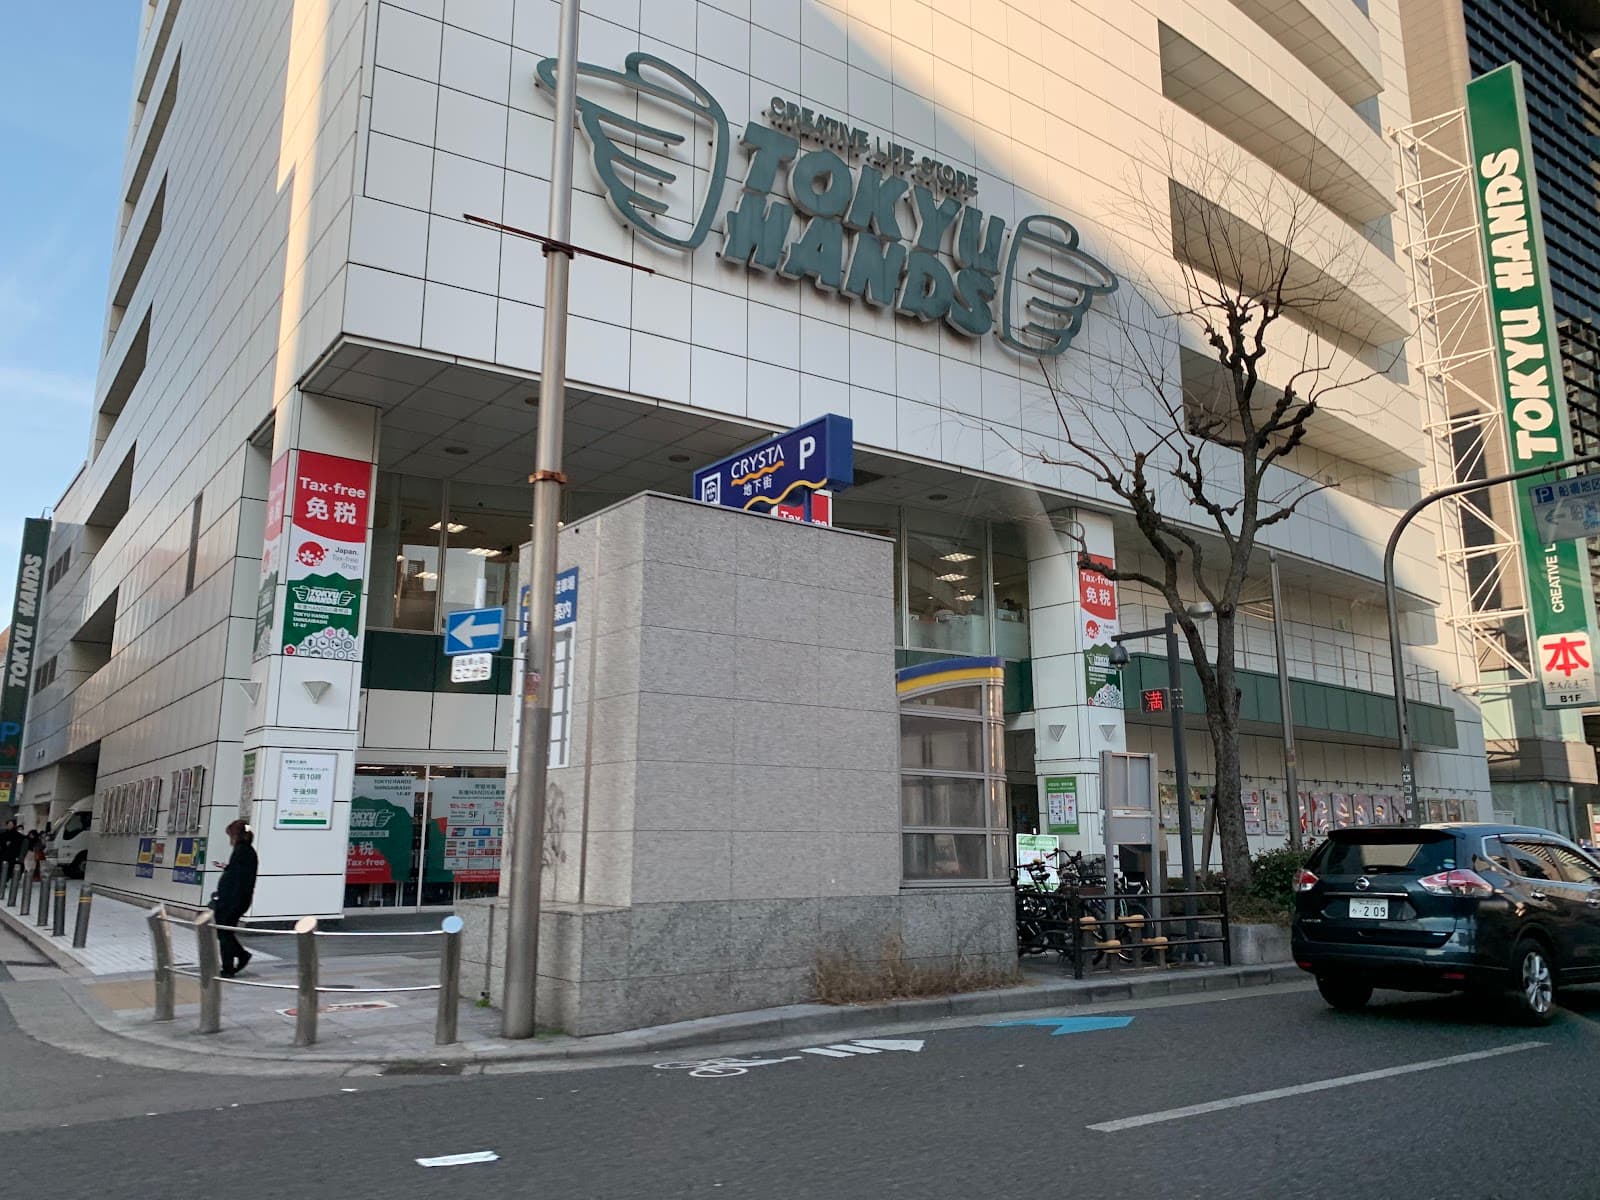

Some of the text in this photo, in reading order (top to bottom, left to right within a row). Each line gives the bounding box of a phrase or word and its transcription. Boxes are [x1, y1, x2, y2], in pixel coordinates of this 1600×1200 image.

[769, 96, 979, 196] CREATIVE LIFE STORE
[738, 121, 1007, 277] TOKYU
[720, 192, 998, 338] HANDS
[1479, 146, 1559, 462] TOKYU HANDS
[730, 443, 785, 479] CRYSTA
[799, 435, 816, 471] P
[299, 476, 366, 499] Tax-free
[742, 474, 772, 497] 地下街
[305, 496, 357, 525] 免税
[310, 588, 340, 599] TOKYU
[1085, 586, 1112, 606] 免税
[1545, 554, 1566, 614] CREATIVE
[8, 553, 43, 688] TOKYU HANDS
[1542, 636, 1590, 677] 本
[455, 666, 489, 680] ここから
[1144, 690, 1163, 712] 満
[1560, 693, 1582, 703] B1F
[0, 721, 20, 742] P
